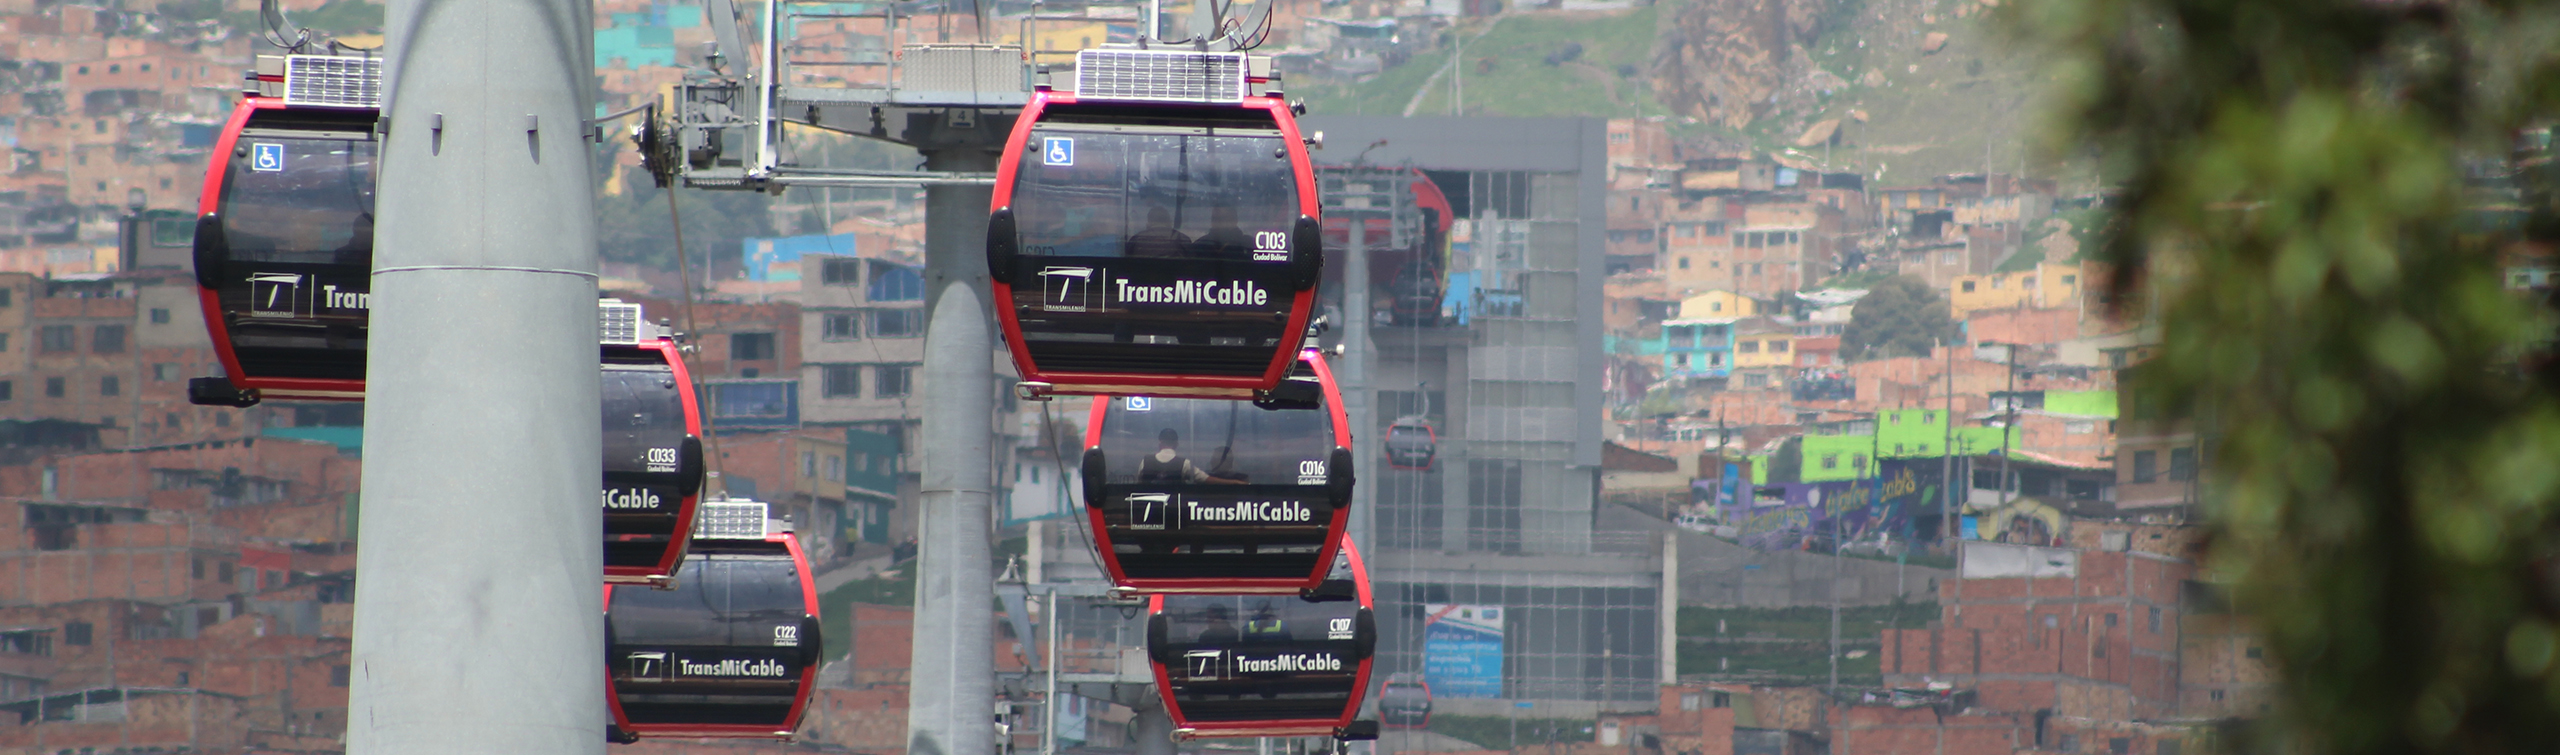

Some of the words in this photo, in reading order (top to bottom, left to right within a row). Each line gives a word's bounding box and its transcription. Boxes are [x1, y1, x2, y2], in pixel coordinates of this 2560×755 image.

[1255, 231, 1286, 250] C103
[1253, 253, 1270, 262] Ciudad
[1115, 278, 1268, 306] TransMiCable
[1045, 304, 1085, 312] TRANSMILENIO
[648, 448, 676, 463] C033
[1299, 460, 1325, 475] C016
[602, 487, 660, 509] iCable
[1187, 501, 1311, 522] TransMiCable
[775, 625, 797, 638] C122
[1330, 618, 1351, 631] C107
[680, 658, 785, 675] TransMiCable
[1236, 652, 1341, 673] TransMiCable
